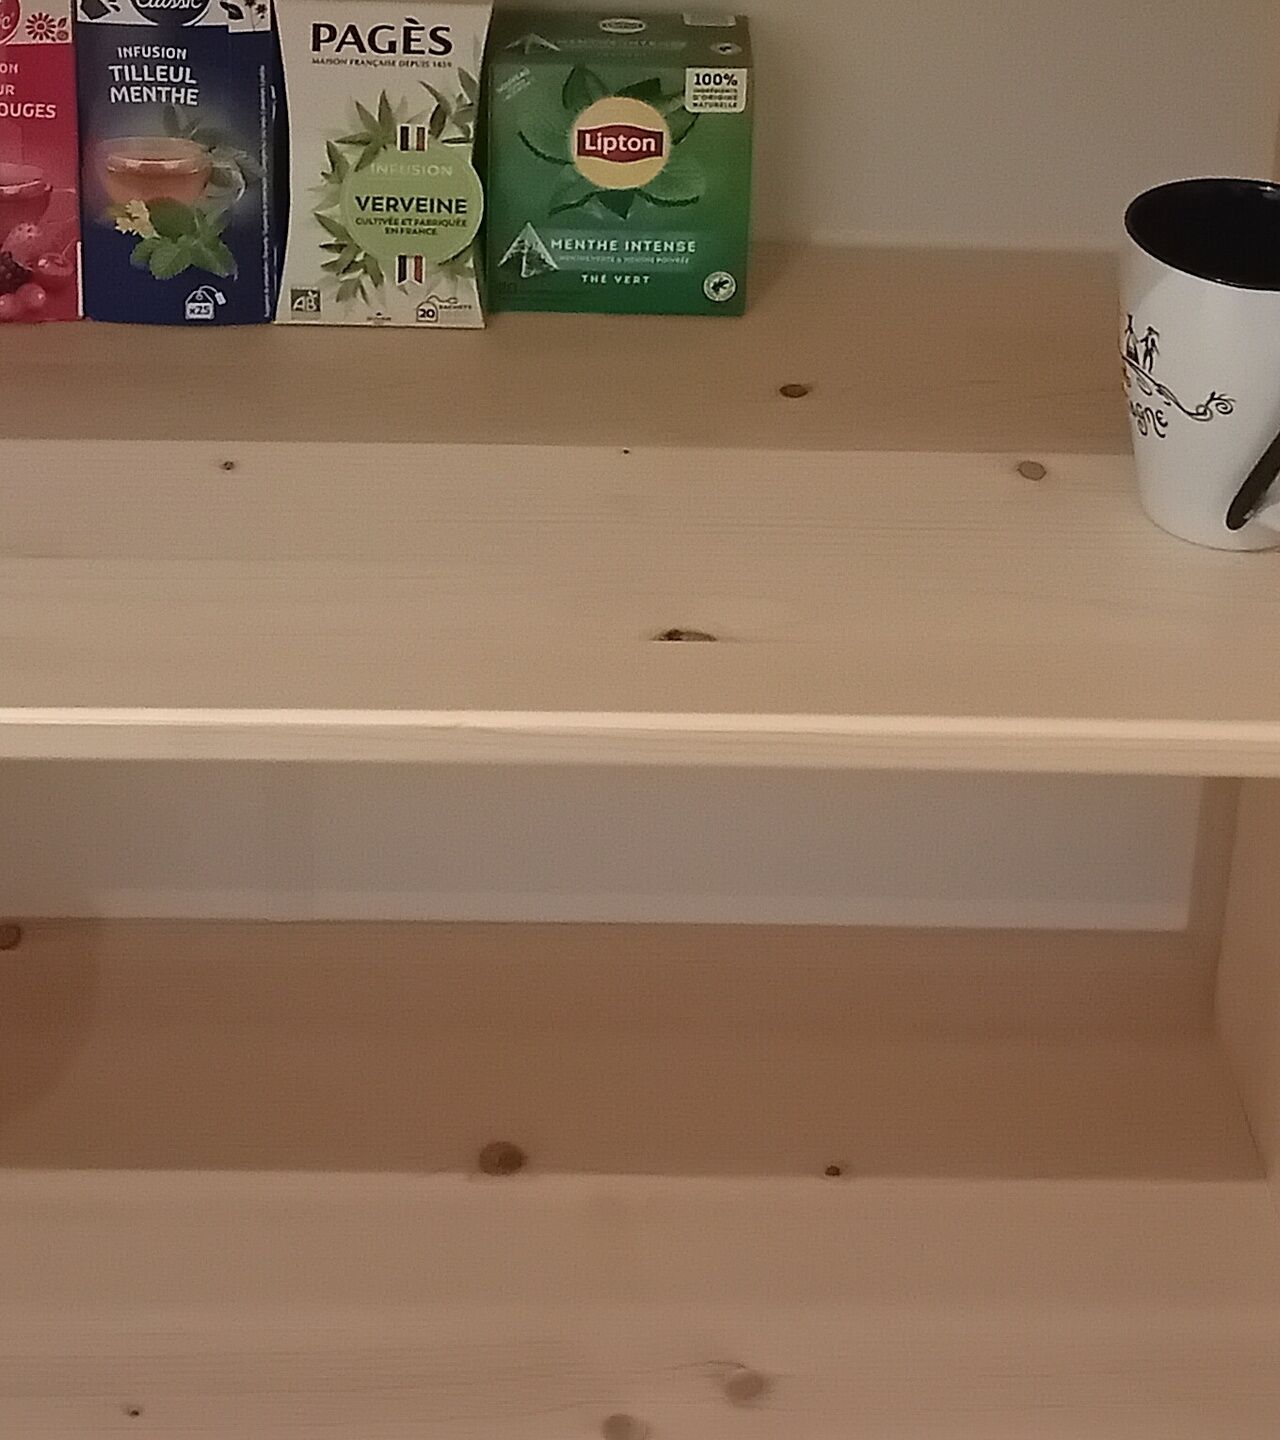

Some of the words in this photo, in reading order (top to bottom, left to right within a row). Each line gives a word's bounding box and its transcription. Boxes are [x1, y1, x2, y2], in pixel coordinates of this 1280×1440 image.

[312, 17, 453, 56] PAGÈS
[117, 46, 188, 60] INFUSION
[109, 65, 198, 84] TILLEUL
[694, 73, 738, 86] 100%
[111, 86, 200, 106] MENTHE
[584, 133, 656, 155] Lipton
[371, 164, 453, 176] INFUSION
[355, 196, 468, 214] VERVEINE
[551, 239, 618, 252] MENTHE
[624, 240, 696, 253] INTENSE
[614, 275, 650, 284] VERT
[419, 308, 435, 319] 20
